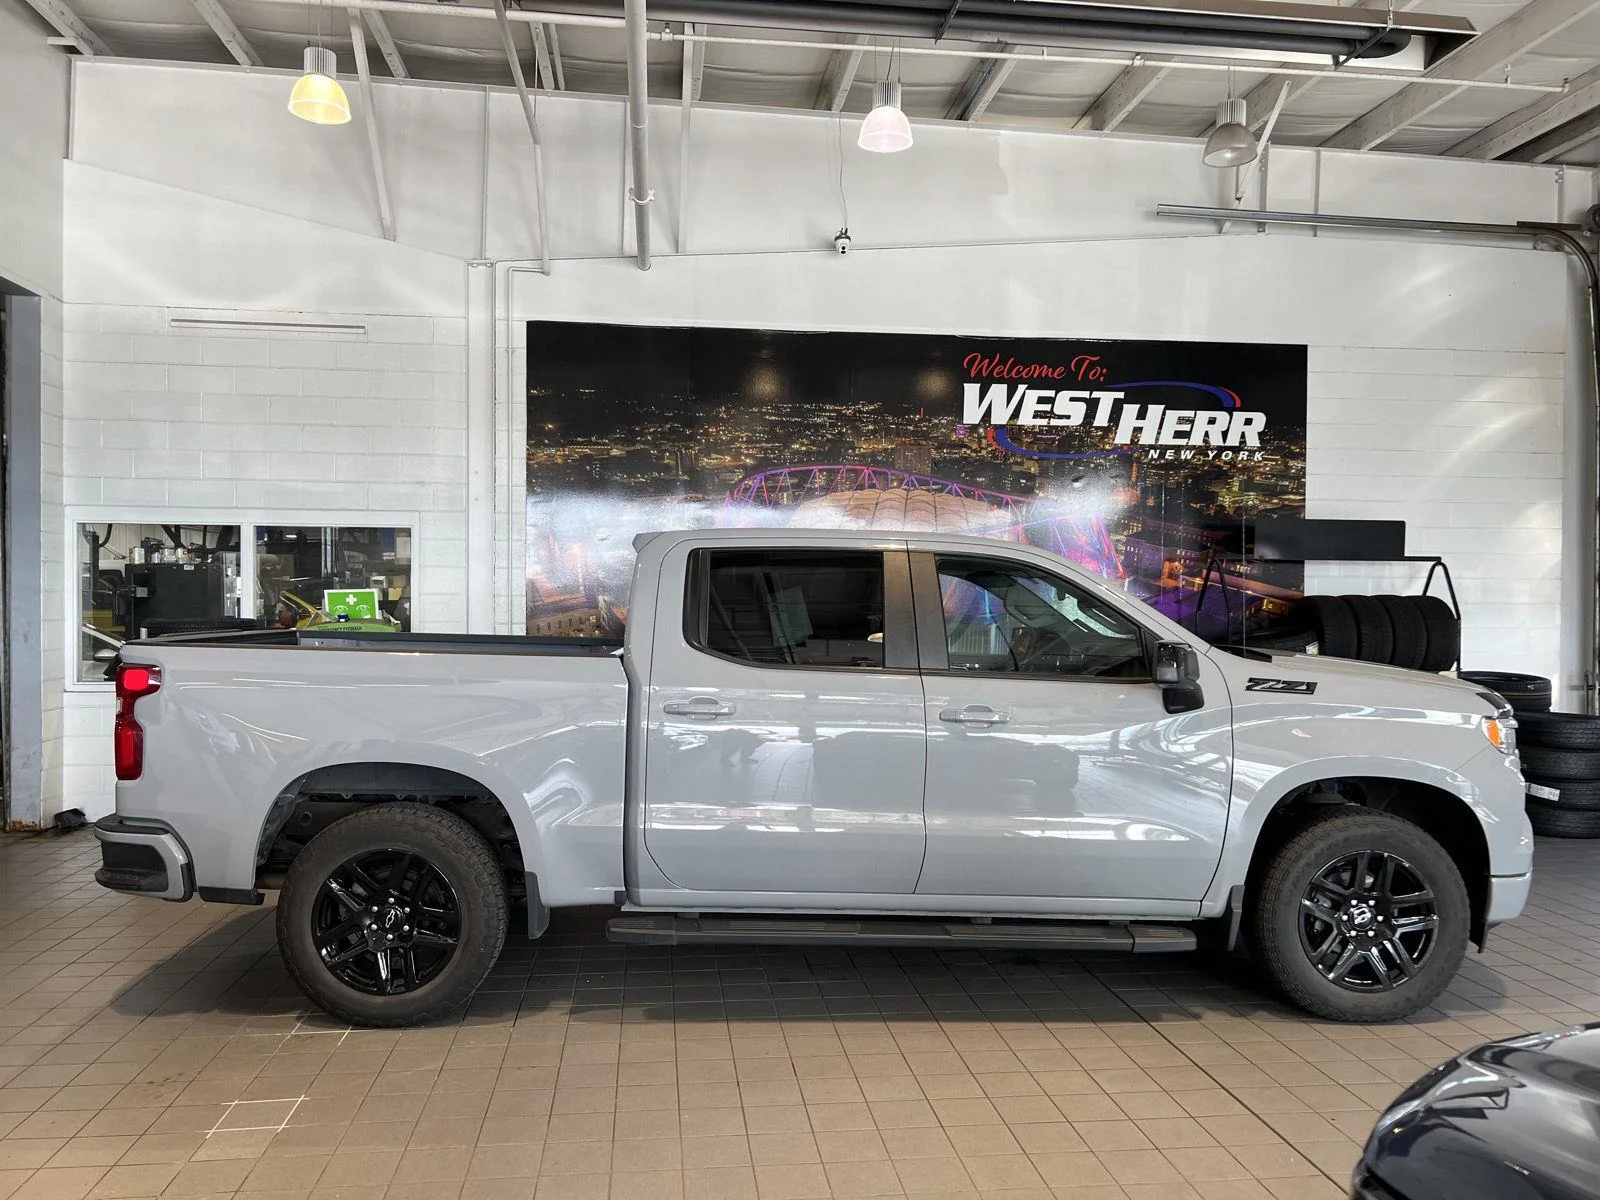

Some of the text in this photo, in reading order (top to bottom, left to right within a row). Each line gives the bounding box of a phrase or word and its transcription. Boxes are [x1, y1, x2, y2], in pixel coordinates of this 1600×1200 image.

[963, 352, 1108, 382] Welcome To:
[963, 383, 1267, 446] WEST HERR
[1148, 449, 1264, 461] NEW YORK
[1245, 677, 1318, 695] Z71
